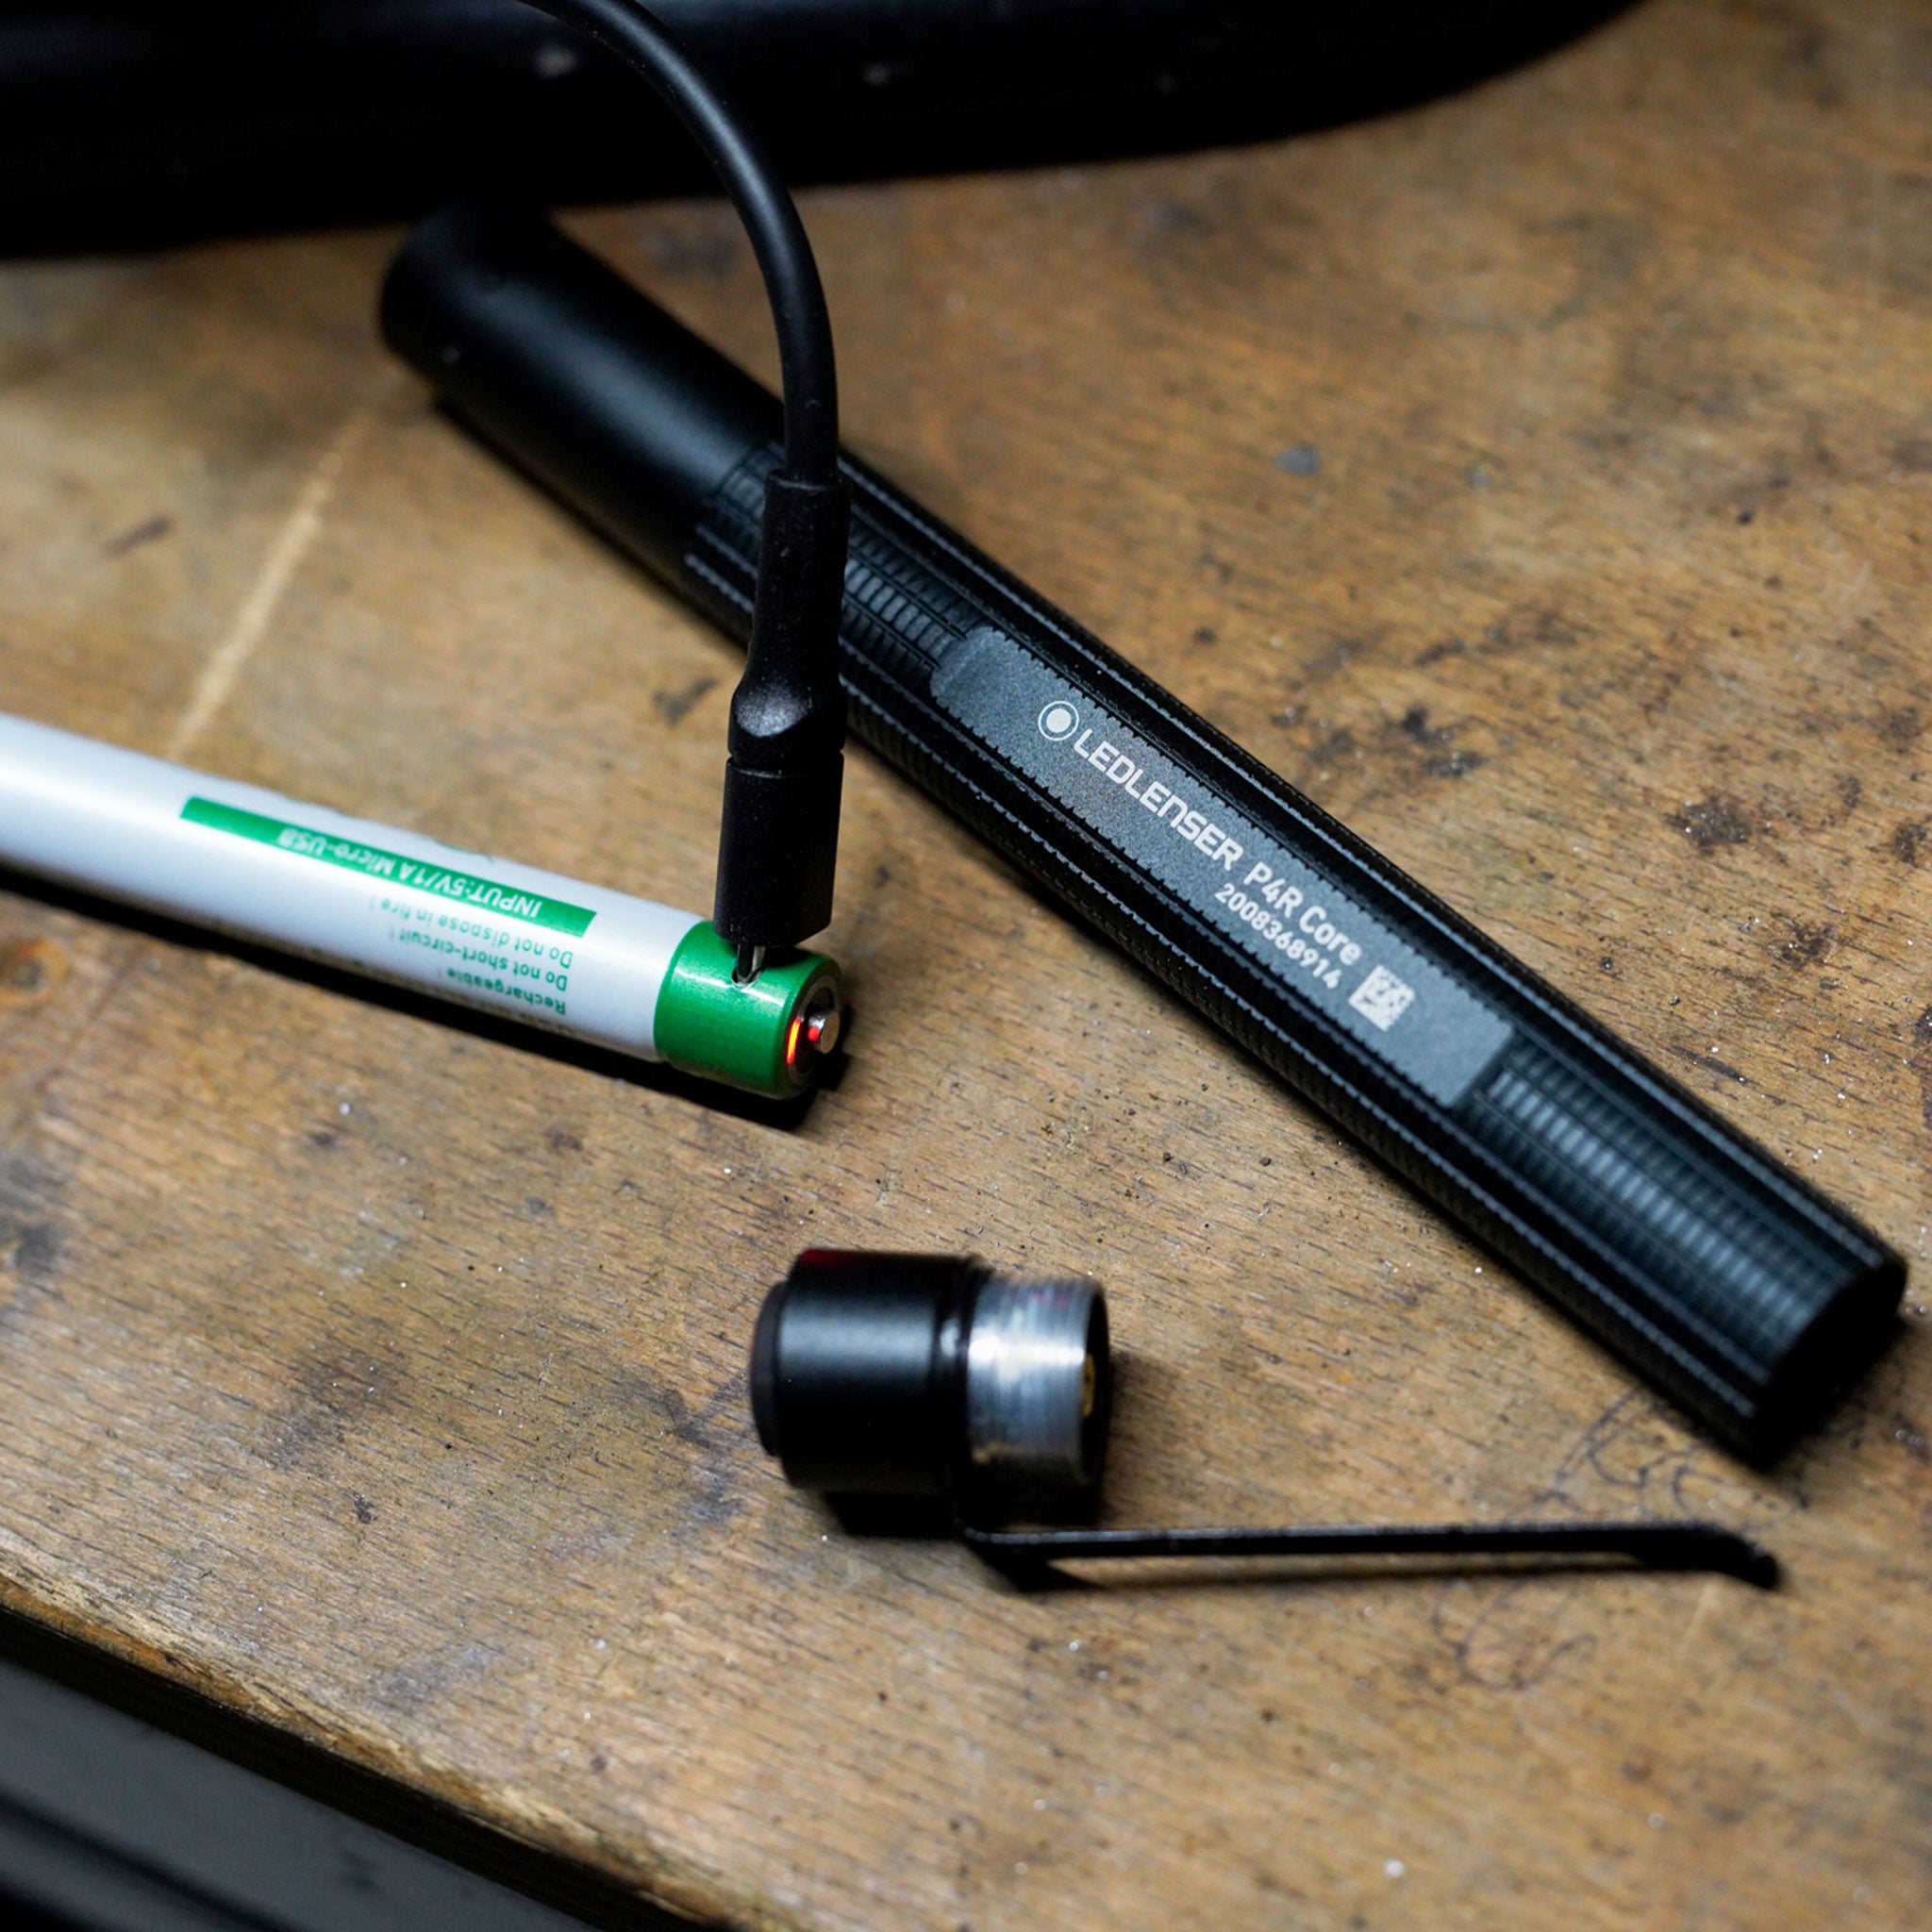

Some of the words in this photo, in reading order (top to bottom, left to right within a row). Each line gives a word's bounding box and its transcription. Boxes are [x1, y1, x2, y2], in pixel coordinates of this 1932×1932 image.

[277, 828, 395, 875] Micro-USB
[1074, 728, 1244, 872] LEDLENSER
[1243, 861, 1304, 919] P4R
[1299, 906, 1362, 966] Core
[416, 910, 433, 926] in
[438, 915, 509, 946] dispose
[1214, 883, 1342, 989] 2008368914
[514, 939, 544, 957] not
[549, 947, 574, 970] Do
[513, 961, 541, 979] not
[545, 972, 568, 991] Do
